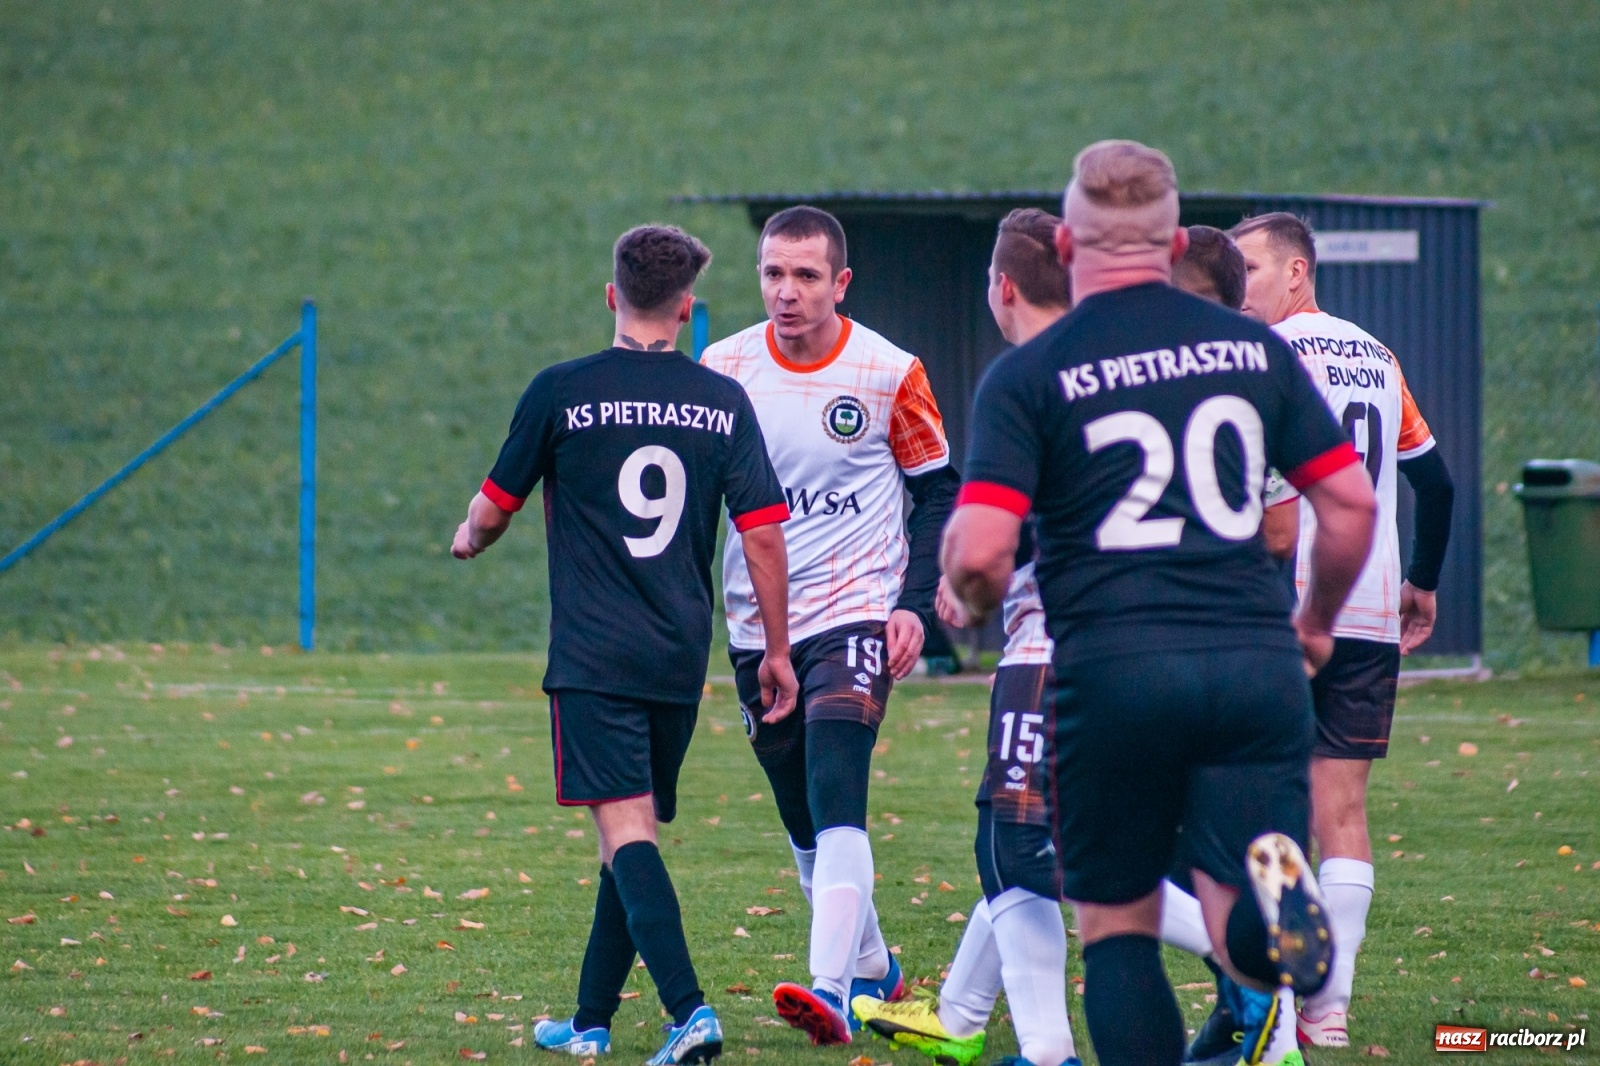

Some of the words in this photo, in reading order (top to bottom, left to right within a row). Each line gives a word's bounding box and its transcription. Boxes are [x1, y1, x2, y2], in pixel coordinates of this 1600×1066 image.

[1059, 363, 1100, 401] KS
[1101, 341, 1268, 390] PIETRASZYN
[1326, 360, 1386, 389] BUKÓW
[566, 404, 594, 430] KS
[600, 401, 734, 436] PIETRASZYN
[1084, 395, 1266, 550] 20
[618, 445, 687, 558] 9
[847, 635, 883, 676] 19
[1001, 712, 1044, 763] 15
